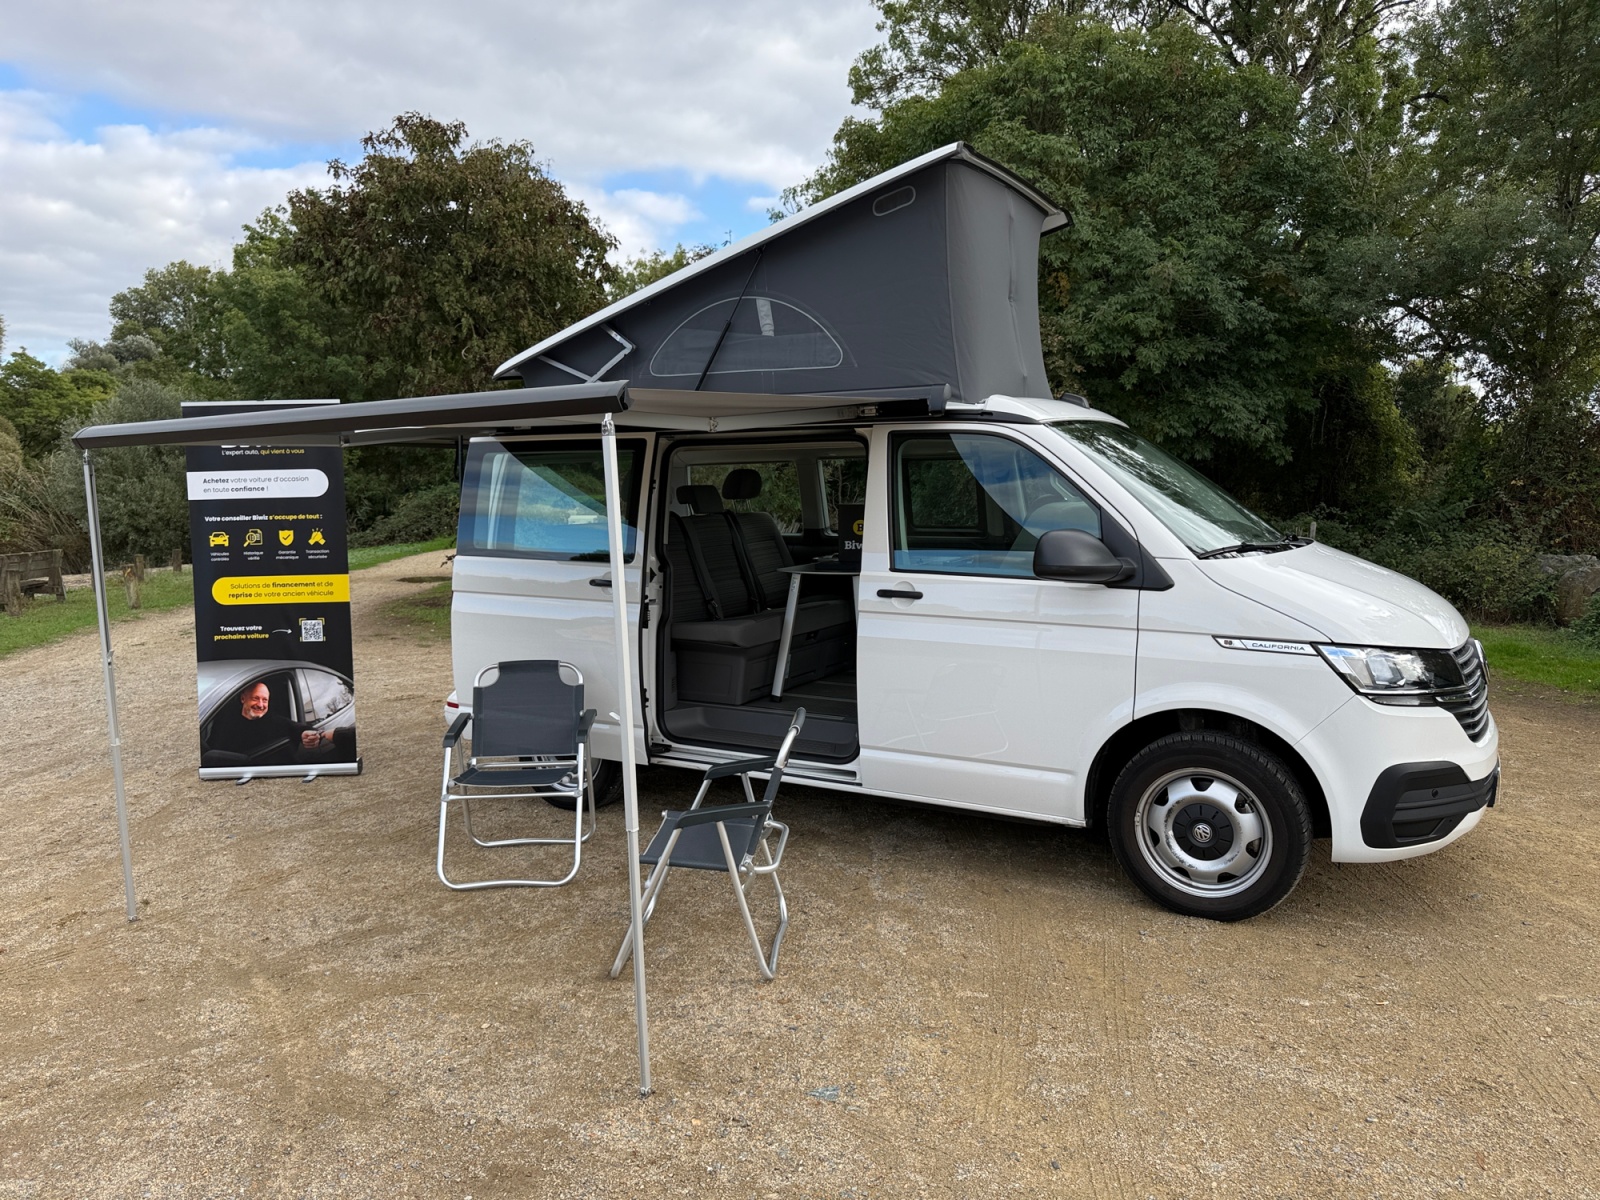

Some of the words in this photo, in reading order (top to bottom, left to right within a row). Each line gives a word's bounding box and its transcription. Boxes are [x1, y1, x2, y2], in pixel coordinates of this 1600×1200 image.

[844, 540, 863, 550] Biw
[214, 632, 246, 641] prochaine
[1252, 642, 1305, 651] CALIFORNIA
